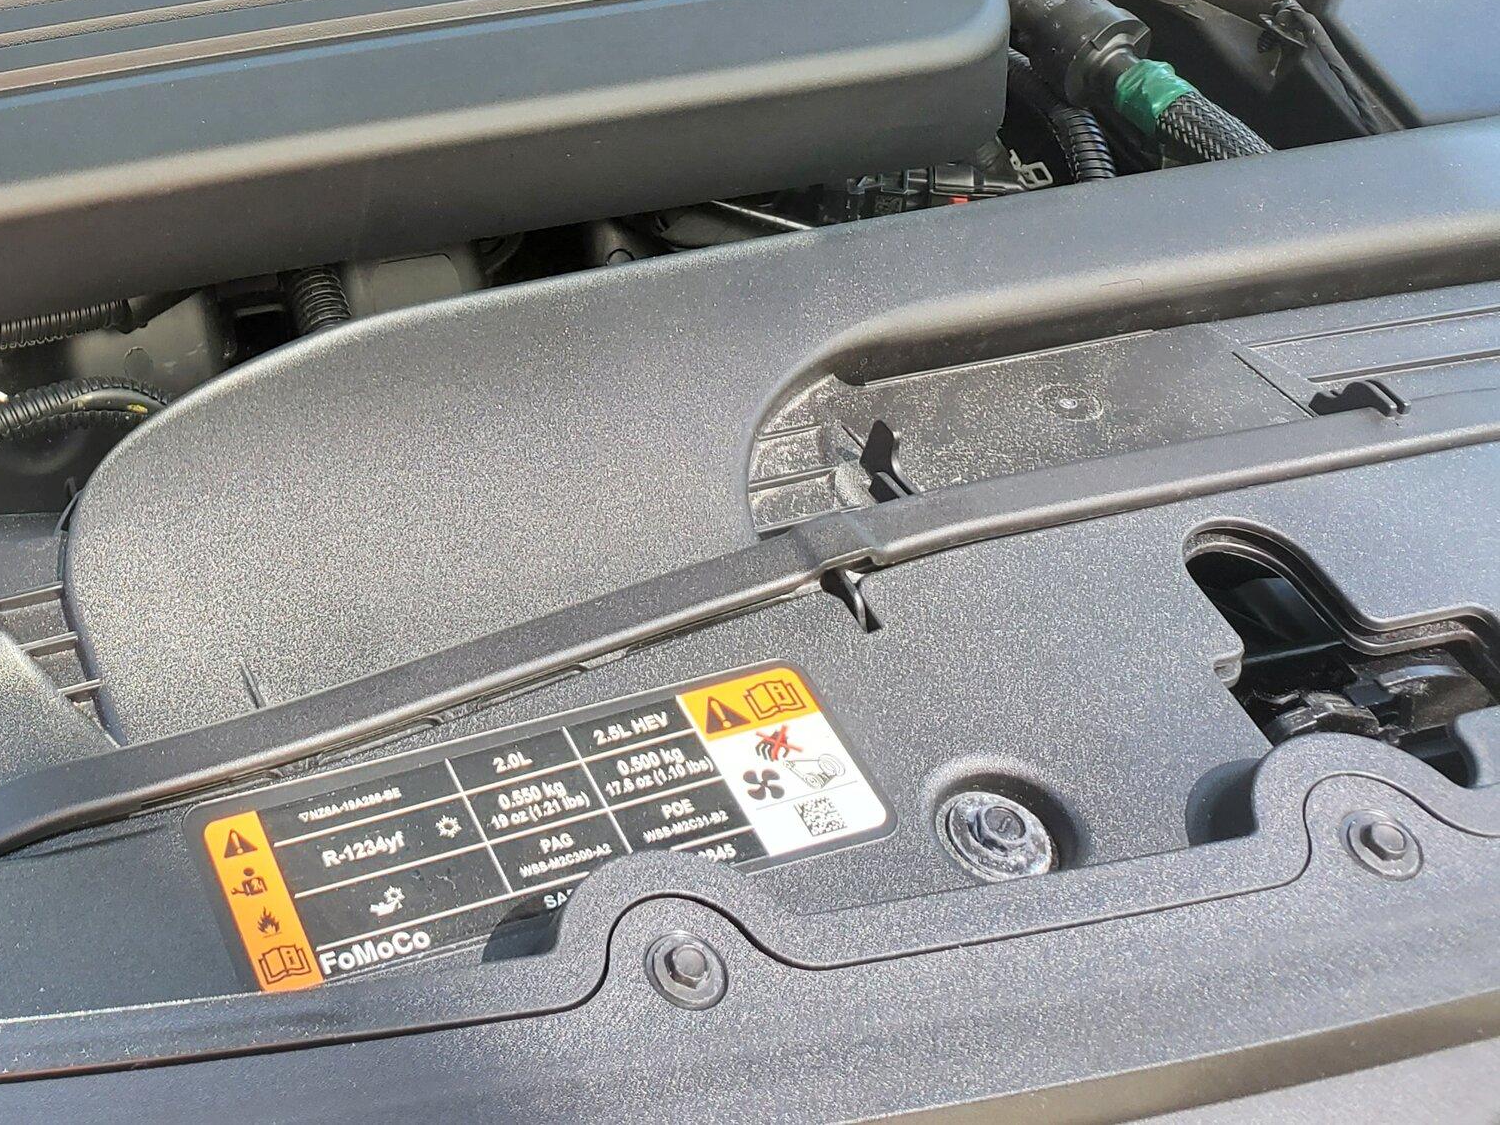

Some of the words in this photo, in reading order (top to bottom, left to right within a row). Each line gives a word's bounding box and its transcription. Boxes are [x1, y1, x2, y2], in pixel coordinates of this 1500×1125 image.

[592, 722, 632, 746] 2.5L
[631, 711, 669, 736] HEV
[492, 751, 534, 775] 2.0L
[615, 750, 659, 777] 0.500
[658, 745, 686, 767] kg
[634, 773, 654, 790] oz
[684, 754, 715, 778] lbs)
[489, 813, 509, 831] 19
[509, 808, 529, 824] oz
[561, 789, 592, 813] lbs)
[497, 783, 542, 812] 0.550
[541, 777, 568, 802] kg
[660, 797, 696, 821] POE
[321, 829, 406, 868] R-1234yf
[538, 832, 574, 855] PAG
[317, 929, 432, 976] FoMoCo
